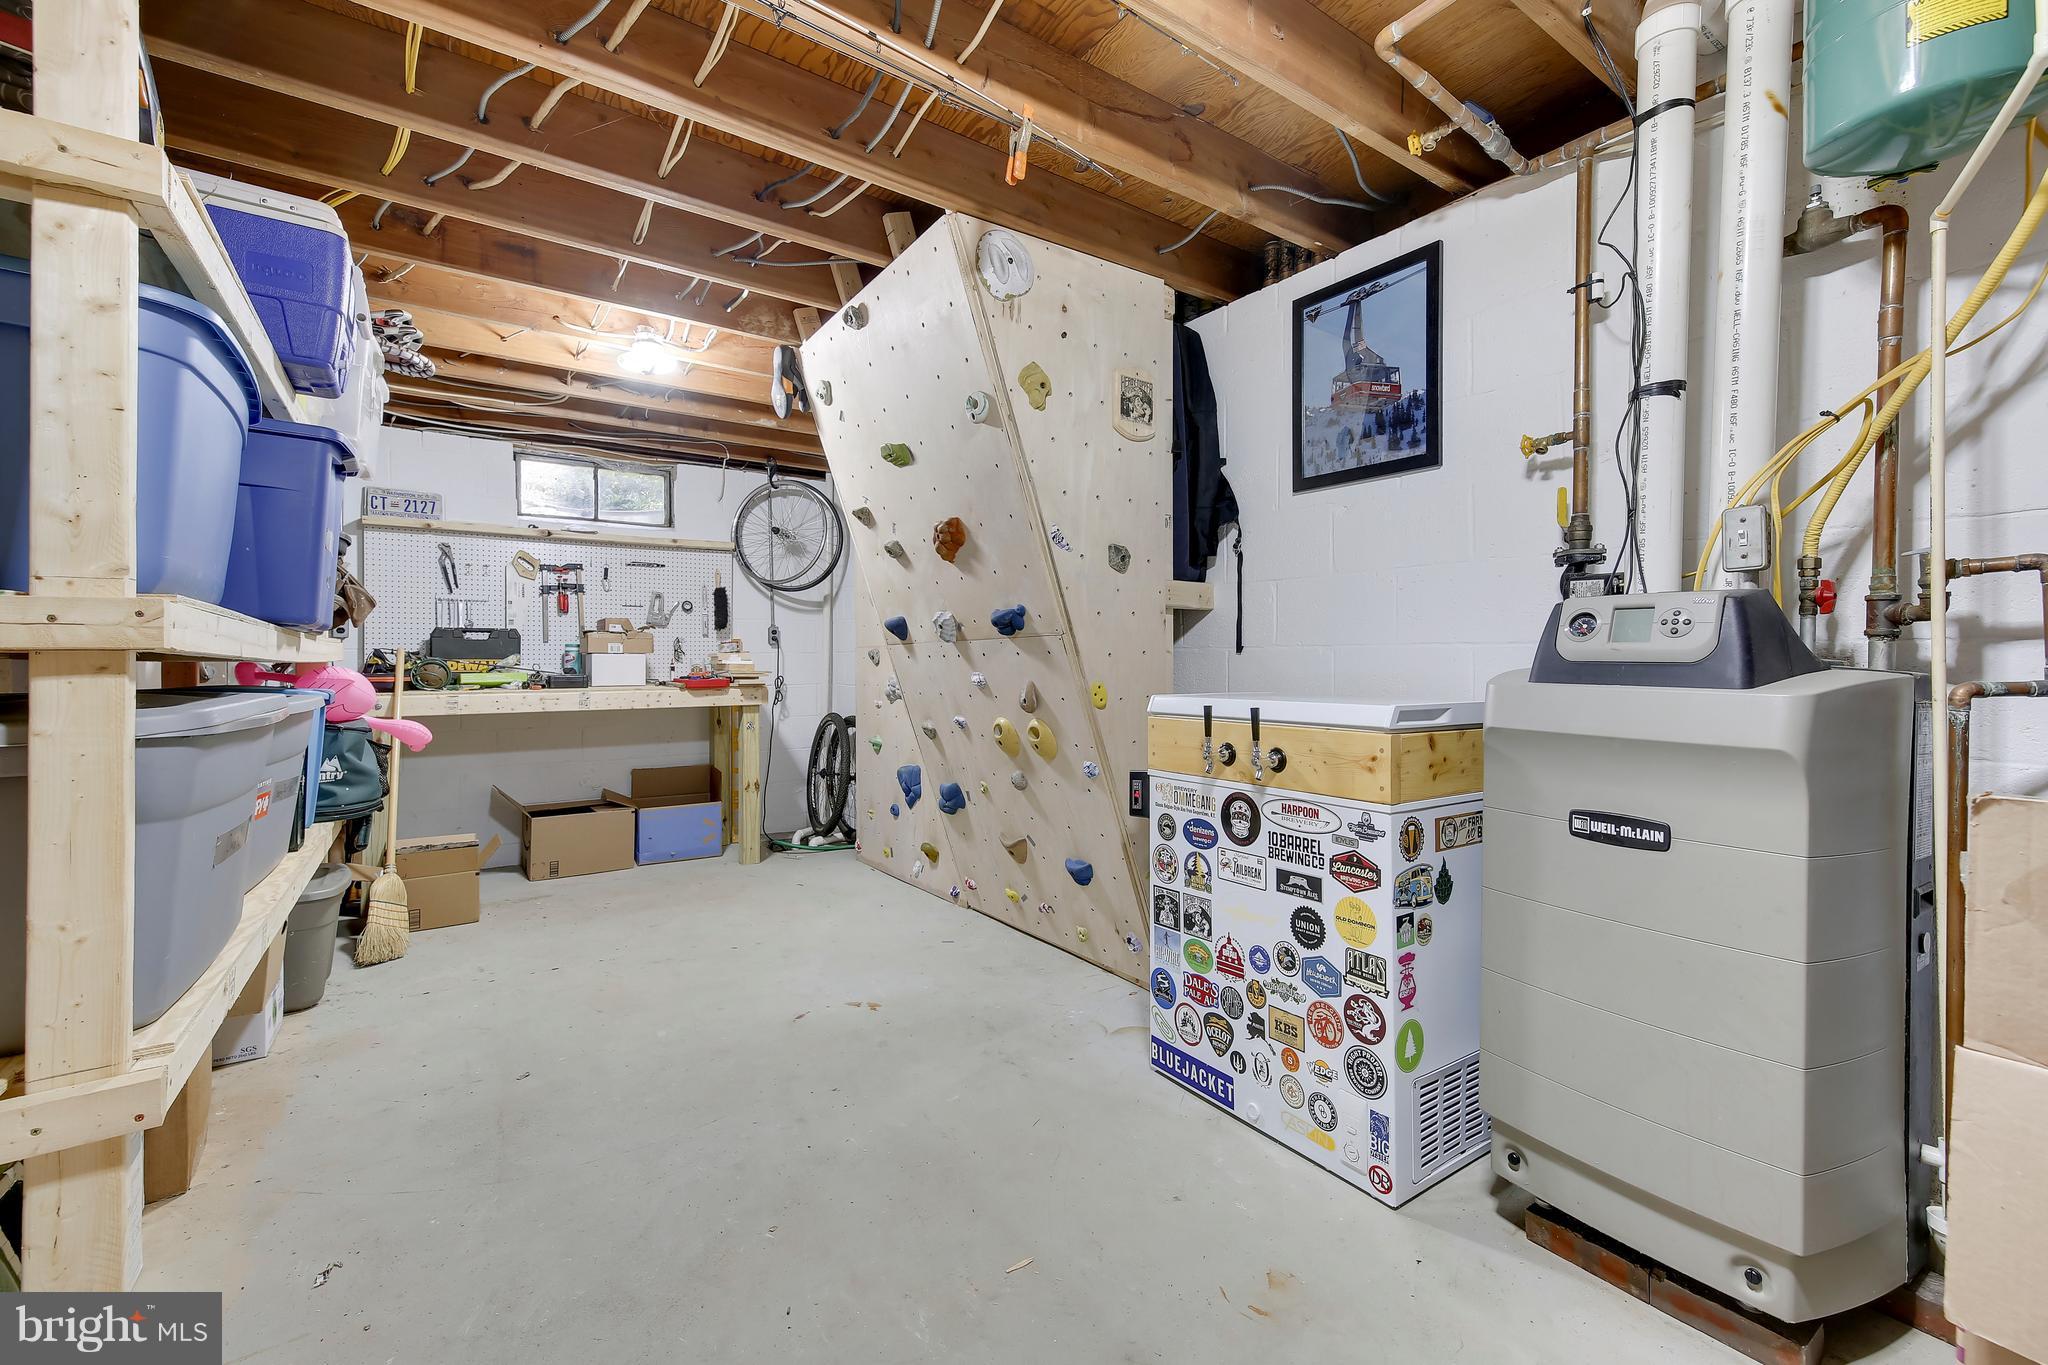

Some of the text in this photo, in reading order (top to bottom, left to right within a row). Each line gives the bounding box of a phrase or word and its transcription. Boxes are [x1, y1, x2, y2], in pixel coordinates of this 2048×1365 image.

[1731, 308, 1740, 362] WELL-CASING
[1730, 366, 1739, 386] ASTM
[370, 496, 436, 514] CT 2127
[320, 770, 344, 780] ntry
[1174, 785, 1198, 793] BREWERY
[1174, 790, 1216, 812] OMMEGANG
[1281, 802, 1320, 819] HARPOON
[1190, 826, 1215, 836] denizens
[1281, 816, 1319, 828] BREWERY
[1232, 857, 1262, 880] JAILBREAK
[1332, 861, 1378, 881] Lancaster
[1296, 918, 1320, 933] UNION
[1348, 918, 1376, 930] DOMINION
[1348, 950, 1386, 984] ATLAS
[1184, 972, 1218, 998] DALE'S
[1184, 986, 1219, 1008] PALE ALE
[1316, 1002, 1342, 1033] BELGIUM
[1206, 1026, 1232, 1044] OCELOT
[1274, 1018, 1298, 1038] KBS
[240, 1044, 258, 1054] SGS
[1152, 1042, 1234, 1102] BLUEJACKET
[1306, 1061, 1338, 1080] WEDGE
[1348, 1050, 1383, 1077] RIGHT PROPER
[1370, 1134, 1390, 1156] BIG
[1371, 1170, 1390, 1191] DB
